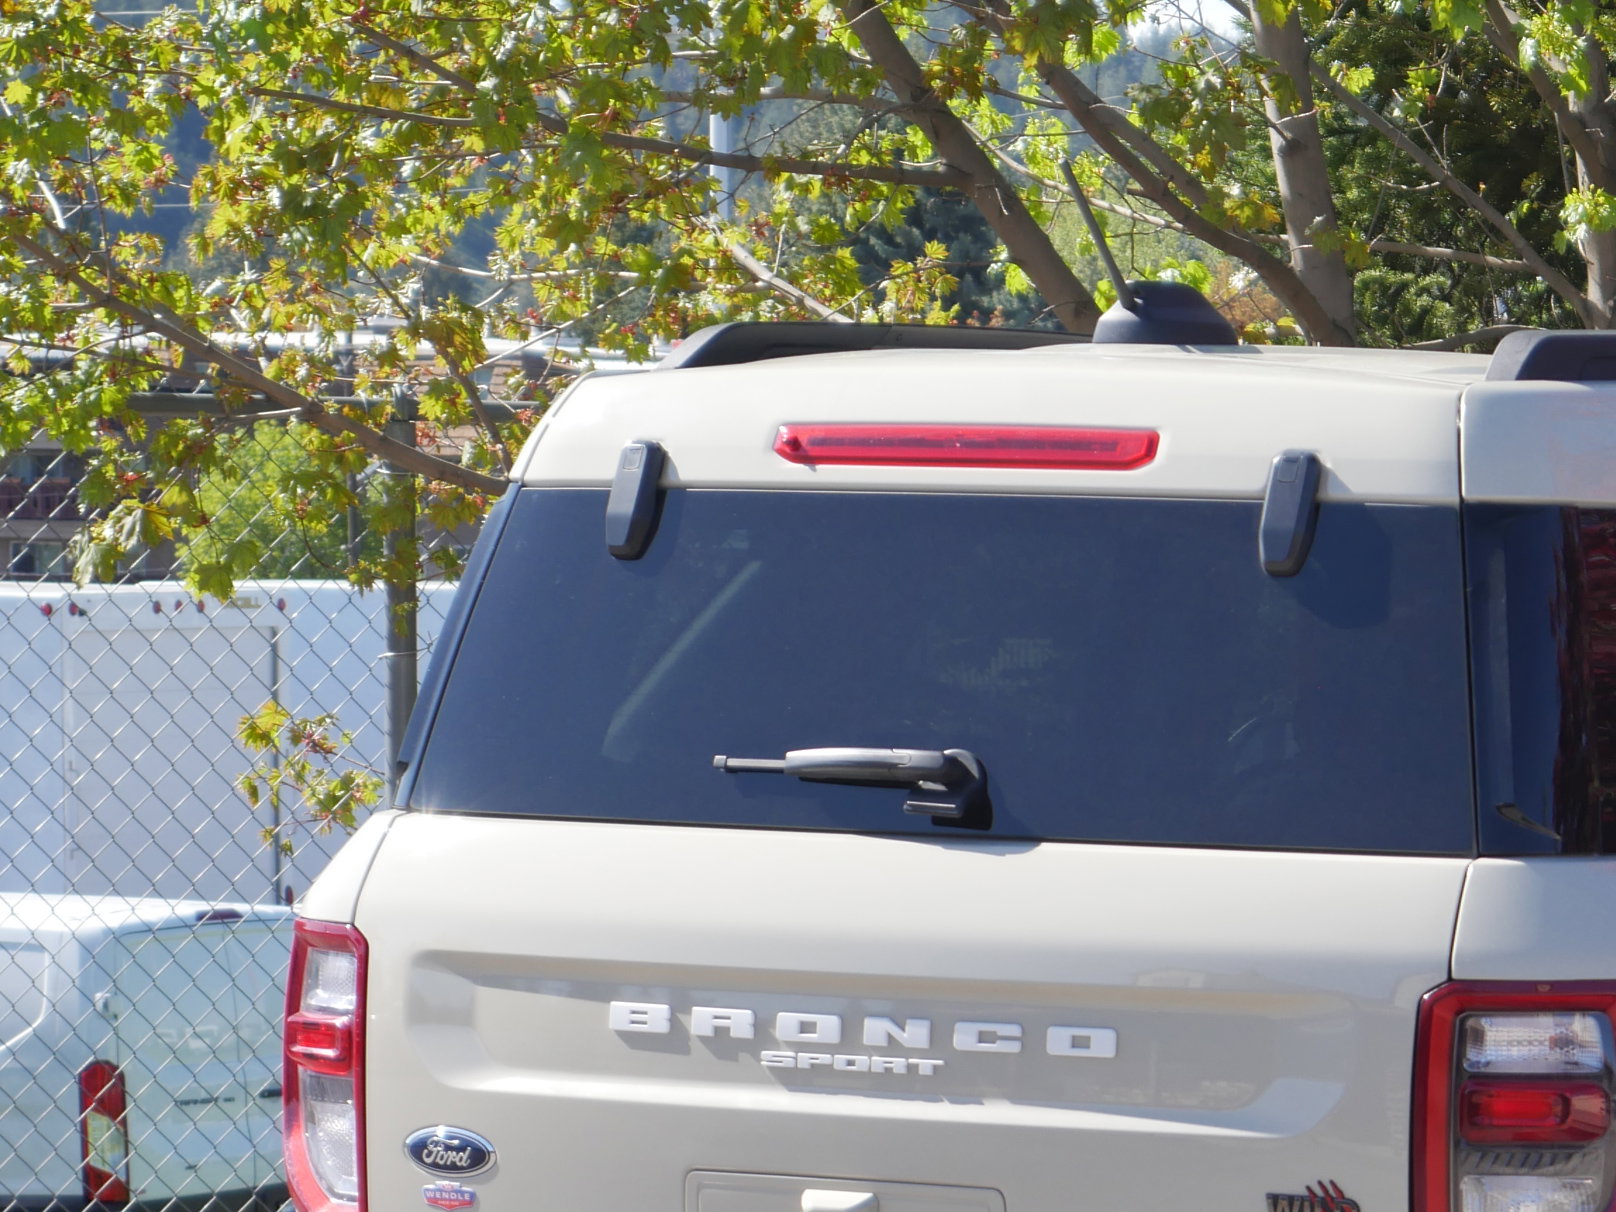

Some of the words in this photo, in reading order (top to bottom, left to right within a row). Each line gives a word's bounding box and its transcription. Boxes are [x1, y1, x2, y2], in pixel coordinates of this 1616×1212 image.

[609, 1001, 1117, 1058] BRONCO
[760, 1050, 945, 1076] SPORT
[423, 1136, 471, 1166] Ford
[425, 1190, 471, 1200] WENDLE
